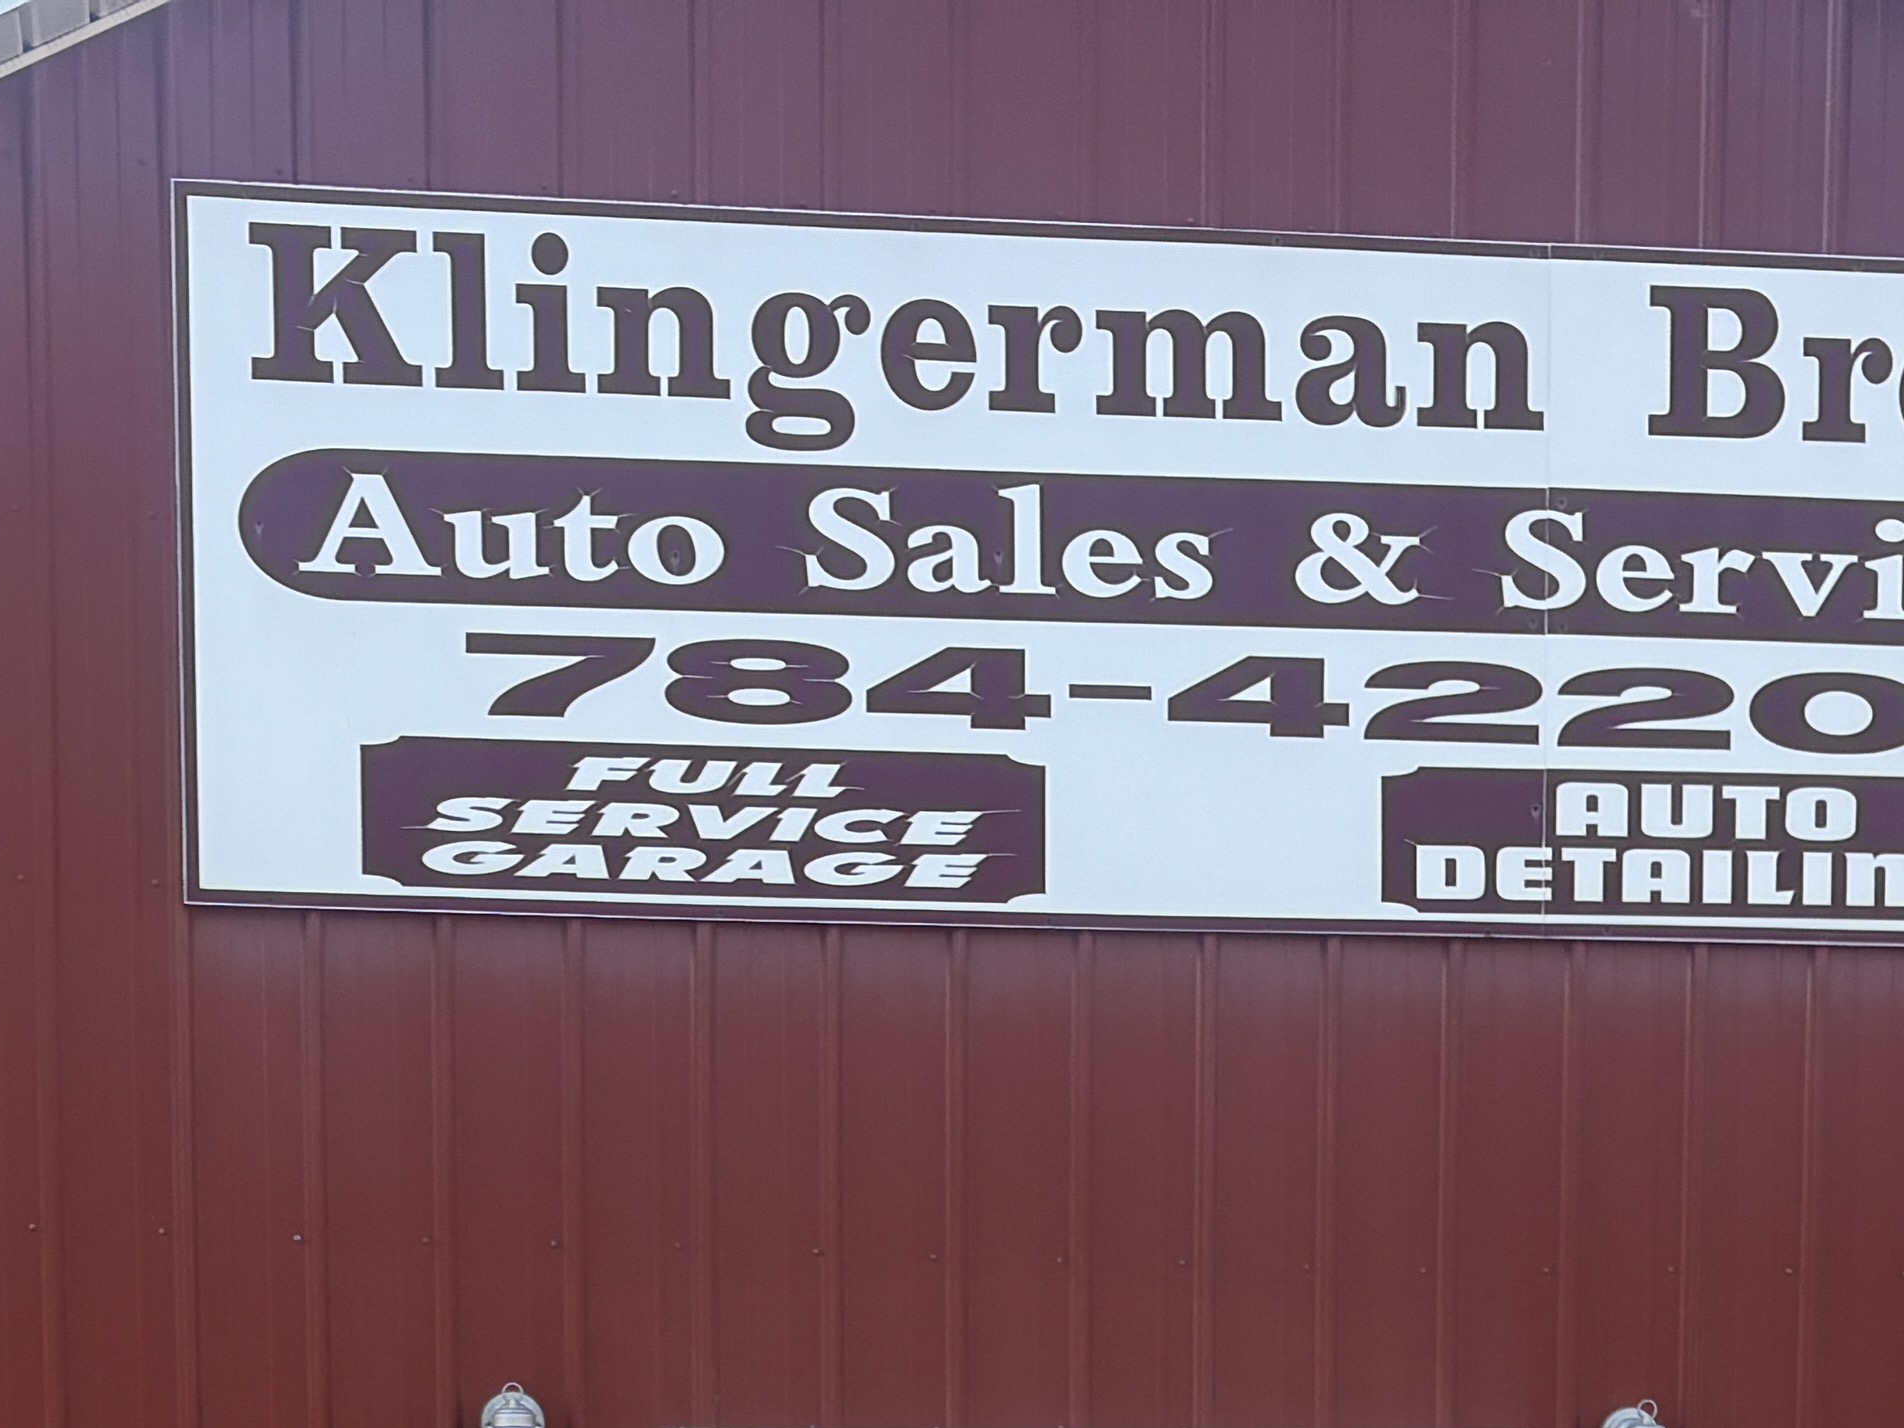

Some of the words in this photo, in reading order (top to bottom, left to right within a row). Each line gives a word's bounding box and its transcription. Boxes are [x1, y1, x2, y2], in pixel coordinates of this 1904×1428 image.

[249, 222, 1545, 452] Klingerman
[298, 473, 725, 585] Auto
[805, 484, 1213, 600] Sales
[1295, 513, 1420, 605] &
[566, 757, 854, 798] FULL
[422, 797, 989, 846] SERVICE
[1556, 782, 1857, 842] AUTO
[422, 841, 988, 889] GARAGE
